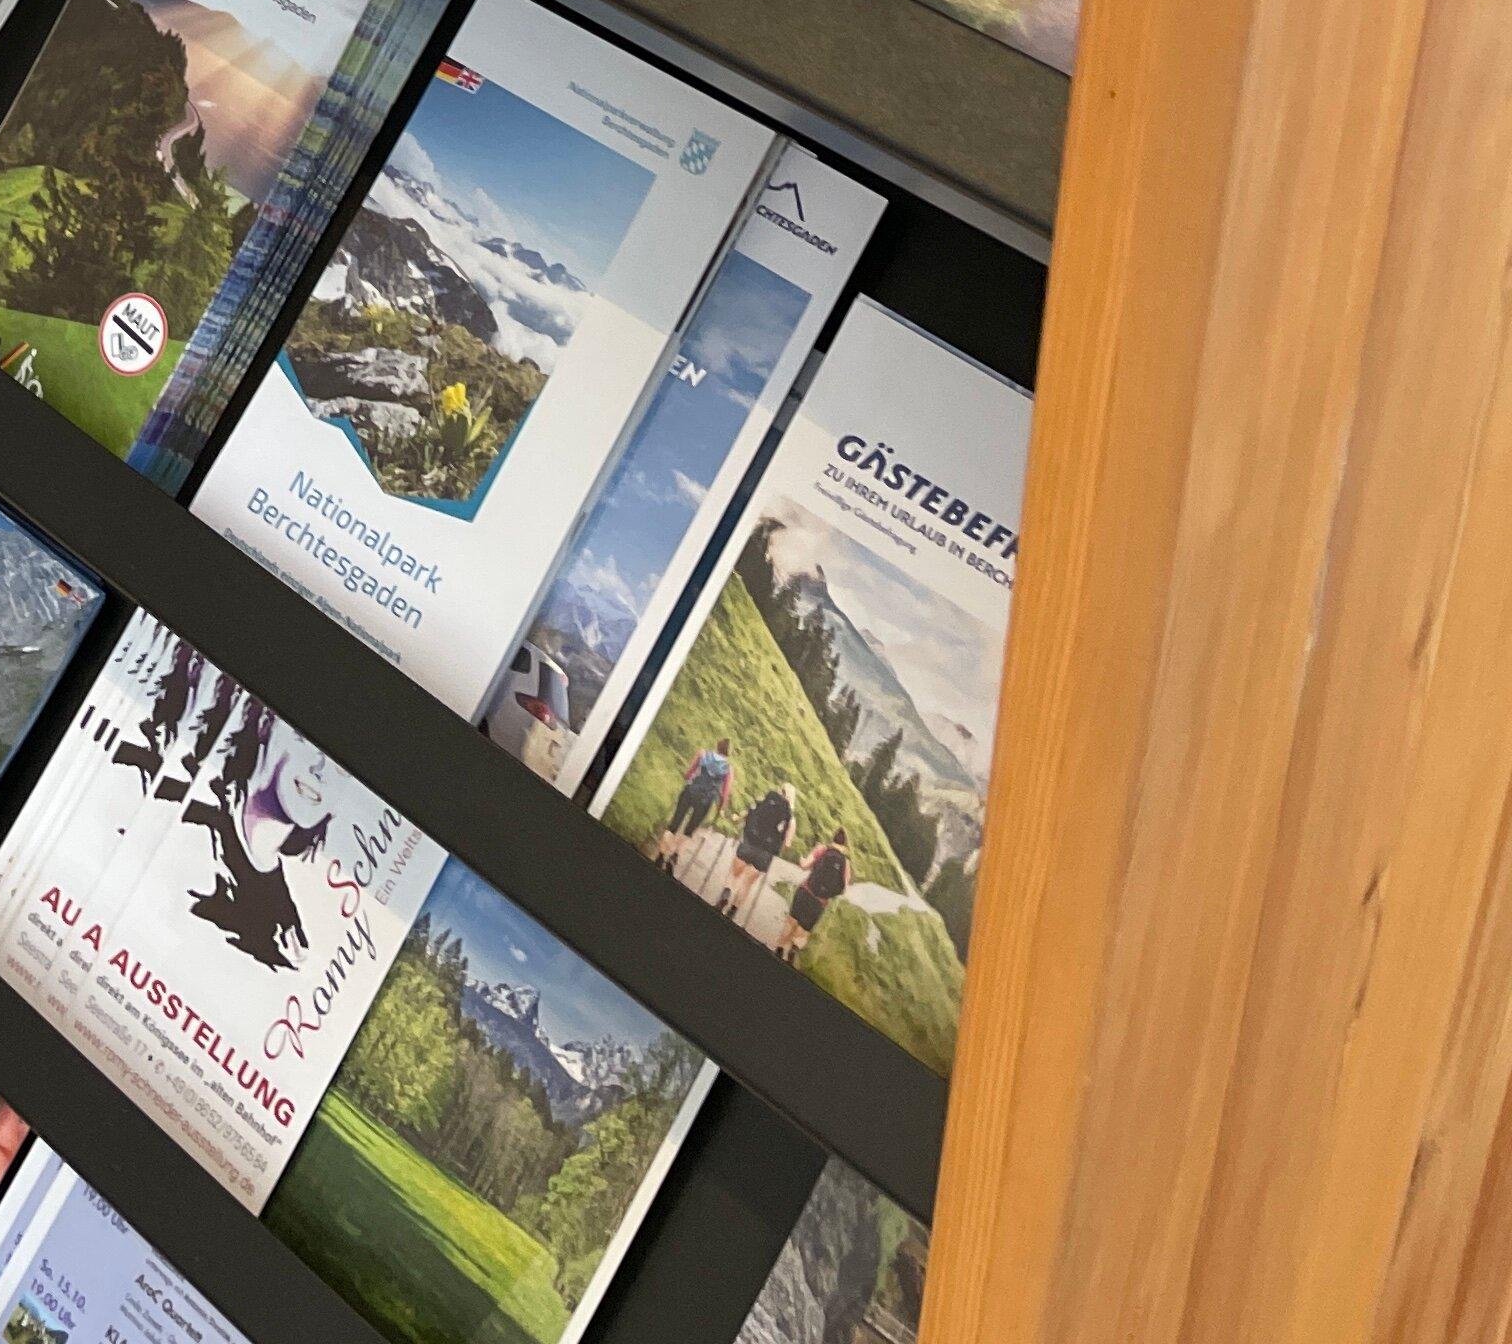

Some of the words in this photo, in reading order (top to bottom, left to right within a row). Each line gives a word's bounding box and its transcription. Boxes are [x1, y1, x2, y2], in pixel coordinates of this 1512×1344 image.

[122, 302, 160, 341] MAUT
[247, 488, 422, 629] Berchtesgaden
[289, 471, 443, 593] Nationalpark
[822, 463, 846, 484] ZU
[842, 476, 891, 512] IHREM
[887, 504, 950, 548] URLAUB
[947, 540, 968, 560] IN
[371, 876, 399, 907] Ein
[41, 886, 82, 927] AU
[82, 923, 103, 952] A
[108, 949, 295, 1128] AUSSTELLUNG
[94, 973, 127, 1004] direkt
[124, 1002, 142, 1019] am
[137, 1014, 195, 1066] Königssee
[189, 1059, 208, 1078] im
[55, 1306, 81, 1331] Uhr
